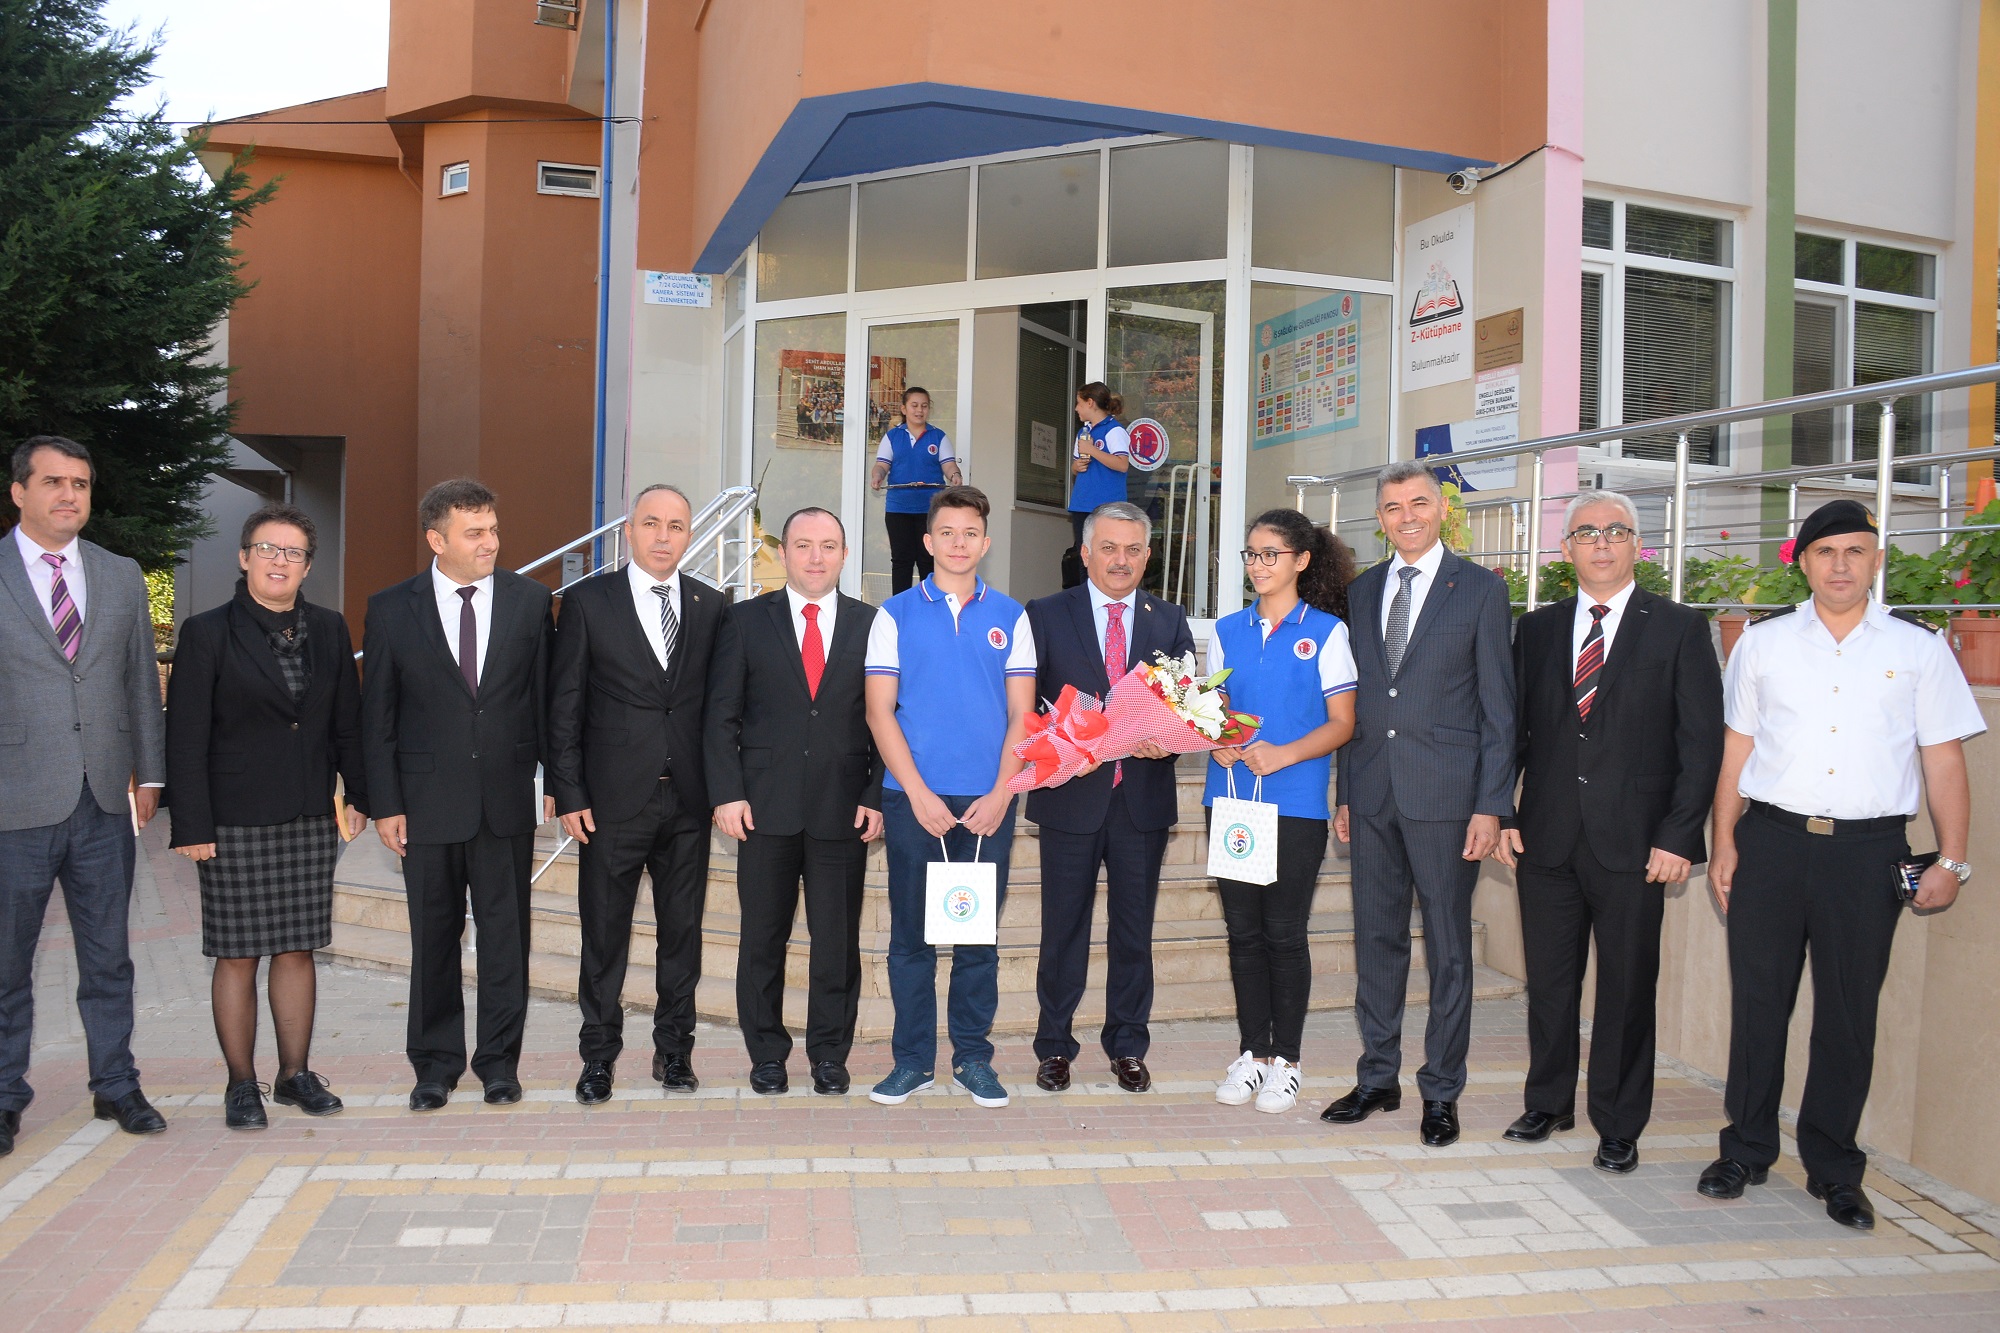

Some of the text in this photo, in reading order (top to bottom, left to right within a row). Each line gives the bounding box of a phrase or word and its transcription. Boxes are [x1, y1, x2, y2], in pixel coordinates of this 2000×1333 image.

[1420, 230, 1454, 250] Bu Okulda
[1321, 309, 1339, 321] PANOSU
[1411, 321, 1462, 343] Z-Kütüphane
[1411, 352, 1461, 372] Bulunmaktadır
[1481, 395, 1513, 407] LÜTFEN BURADAN
[1496, 402, 1518, 412] YAPMAYINIZ
